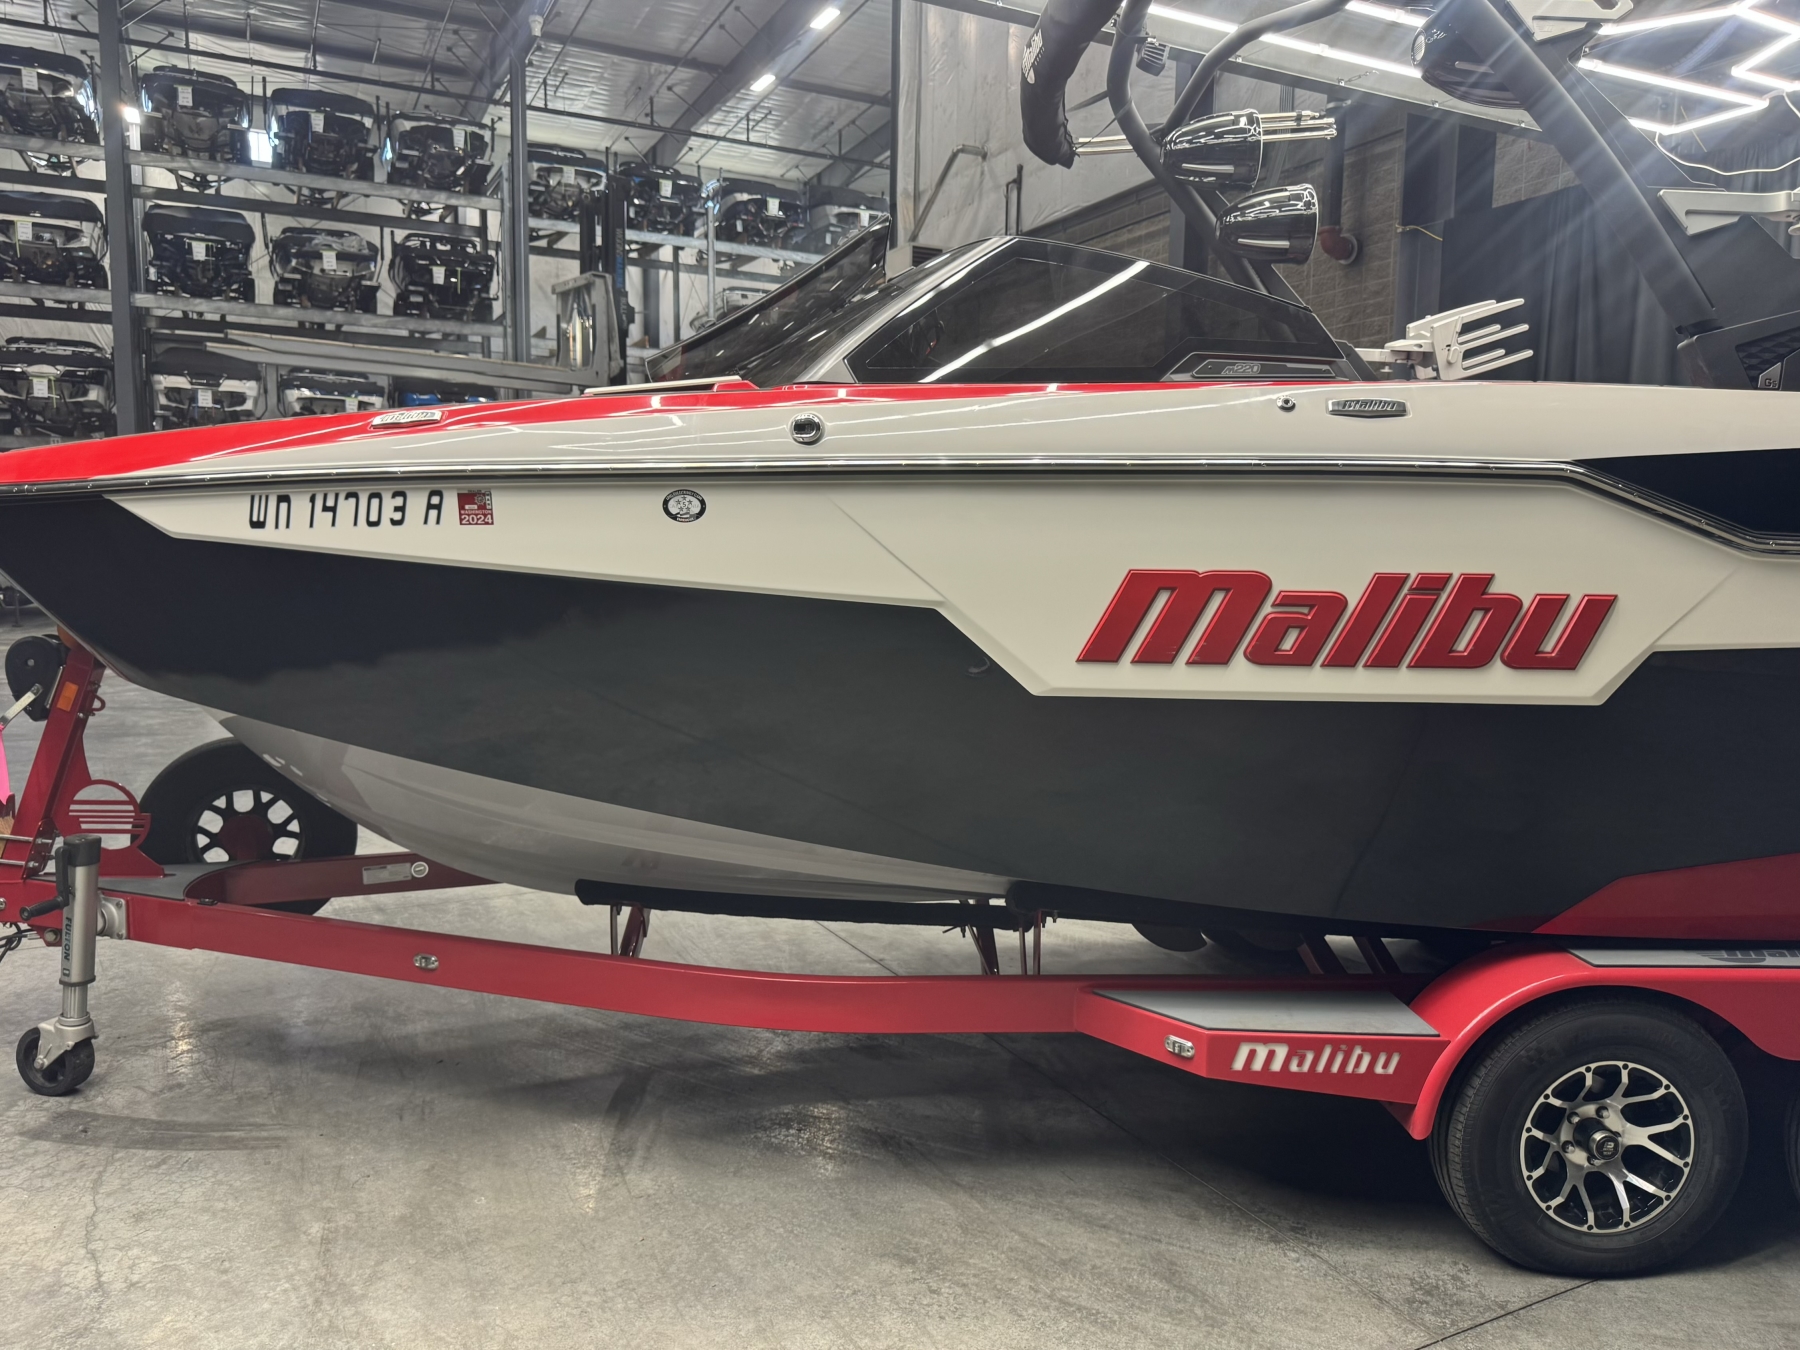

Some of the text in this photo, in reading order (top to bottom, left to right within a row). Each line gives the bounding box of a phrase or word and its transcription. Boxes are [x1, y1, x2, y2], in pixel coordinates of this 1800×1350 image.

[308, 490, 408, 529] 14703
[423, 489, 444, 525] A
[461, 514, 493, 524] 2024
[1076, 569, 1618, 670] Malibu
[64, 916, 72, 961] FULTON
[1230, 1041, 1401, 1075] Malibu
